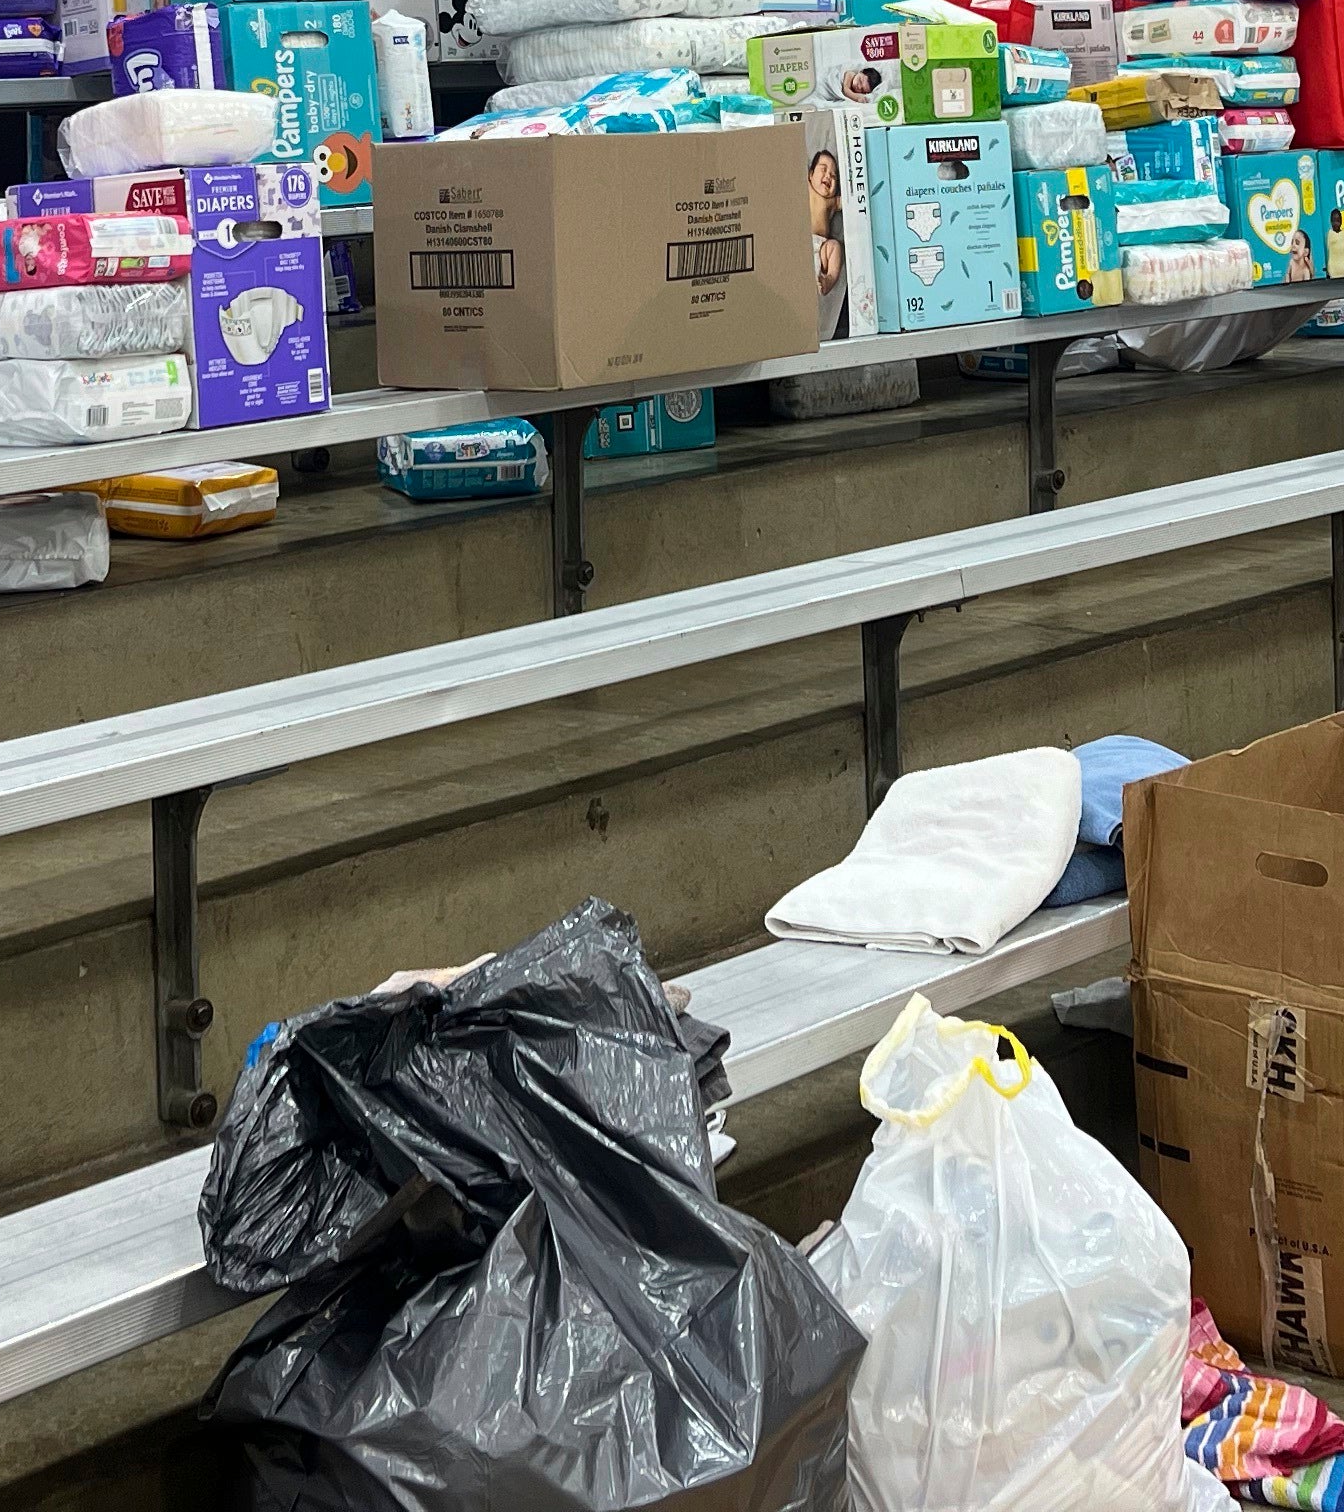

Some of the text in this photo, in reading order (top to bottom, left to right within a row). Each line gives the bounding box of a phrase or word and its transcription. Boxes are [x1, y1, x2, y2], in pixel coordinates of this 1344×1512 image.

[865, 37, 885, 48] SAVE
[769, 61, 809, 74] DIAPERS
[272, 49, 304, 160] Pampers
[307, 70, 318, 133] baby-dry
[928, 139, 978, 153] KIRKLAND
[853, 136, 867, 215] HONEST
[287, 176, 305, 190] 176
[906, 182, 1006, 197] diapers couches pañales
[132, 188, 164, 209] SAVE
[197, 194, 254, 213] DIAPERS
[676, 201, 710, 212] COSTCO
[414, 211, 447, 221] COSTCO
[449, 211, 465, 219] Item
[687, 213, 713, 224] Danish
[1260, 205, 1294, 223] Pampers
[425, 224, 492, 234] Danish Clamshell
[1056, 194, 1076, 291] Pampers
[906, 297, 925, 312] 192
[442, 307, 484, 317] 80 CNT/CS
